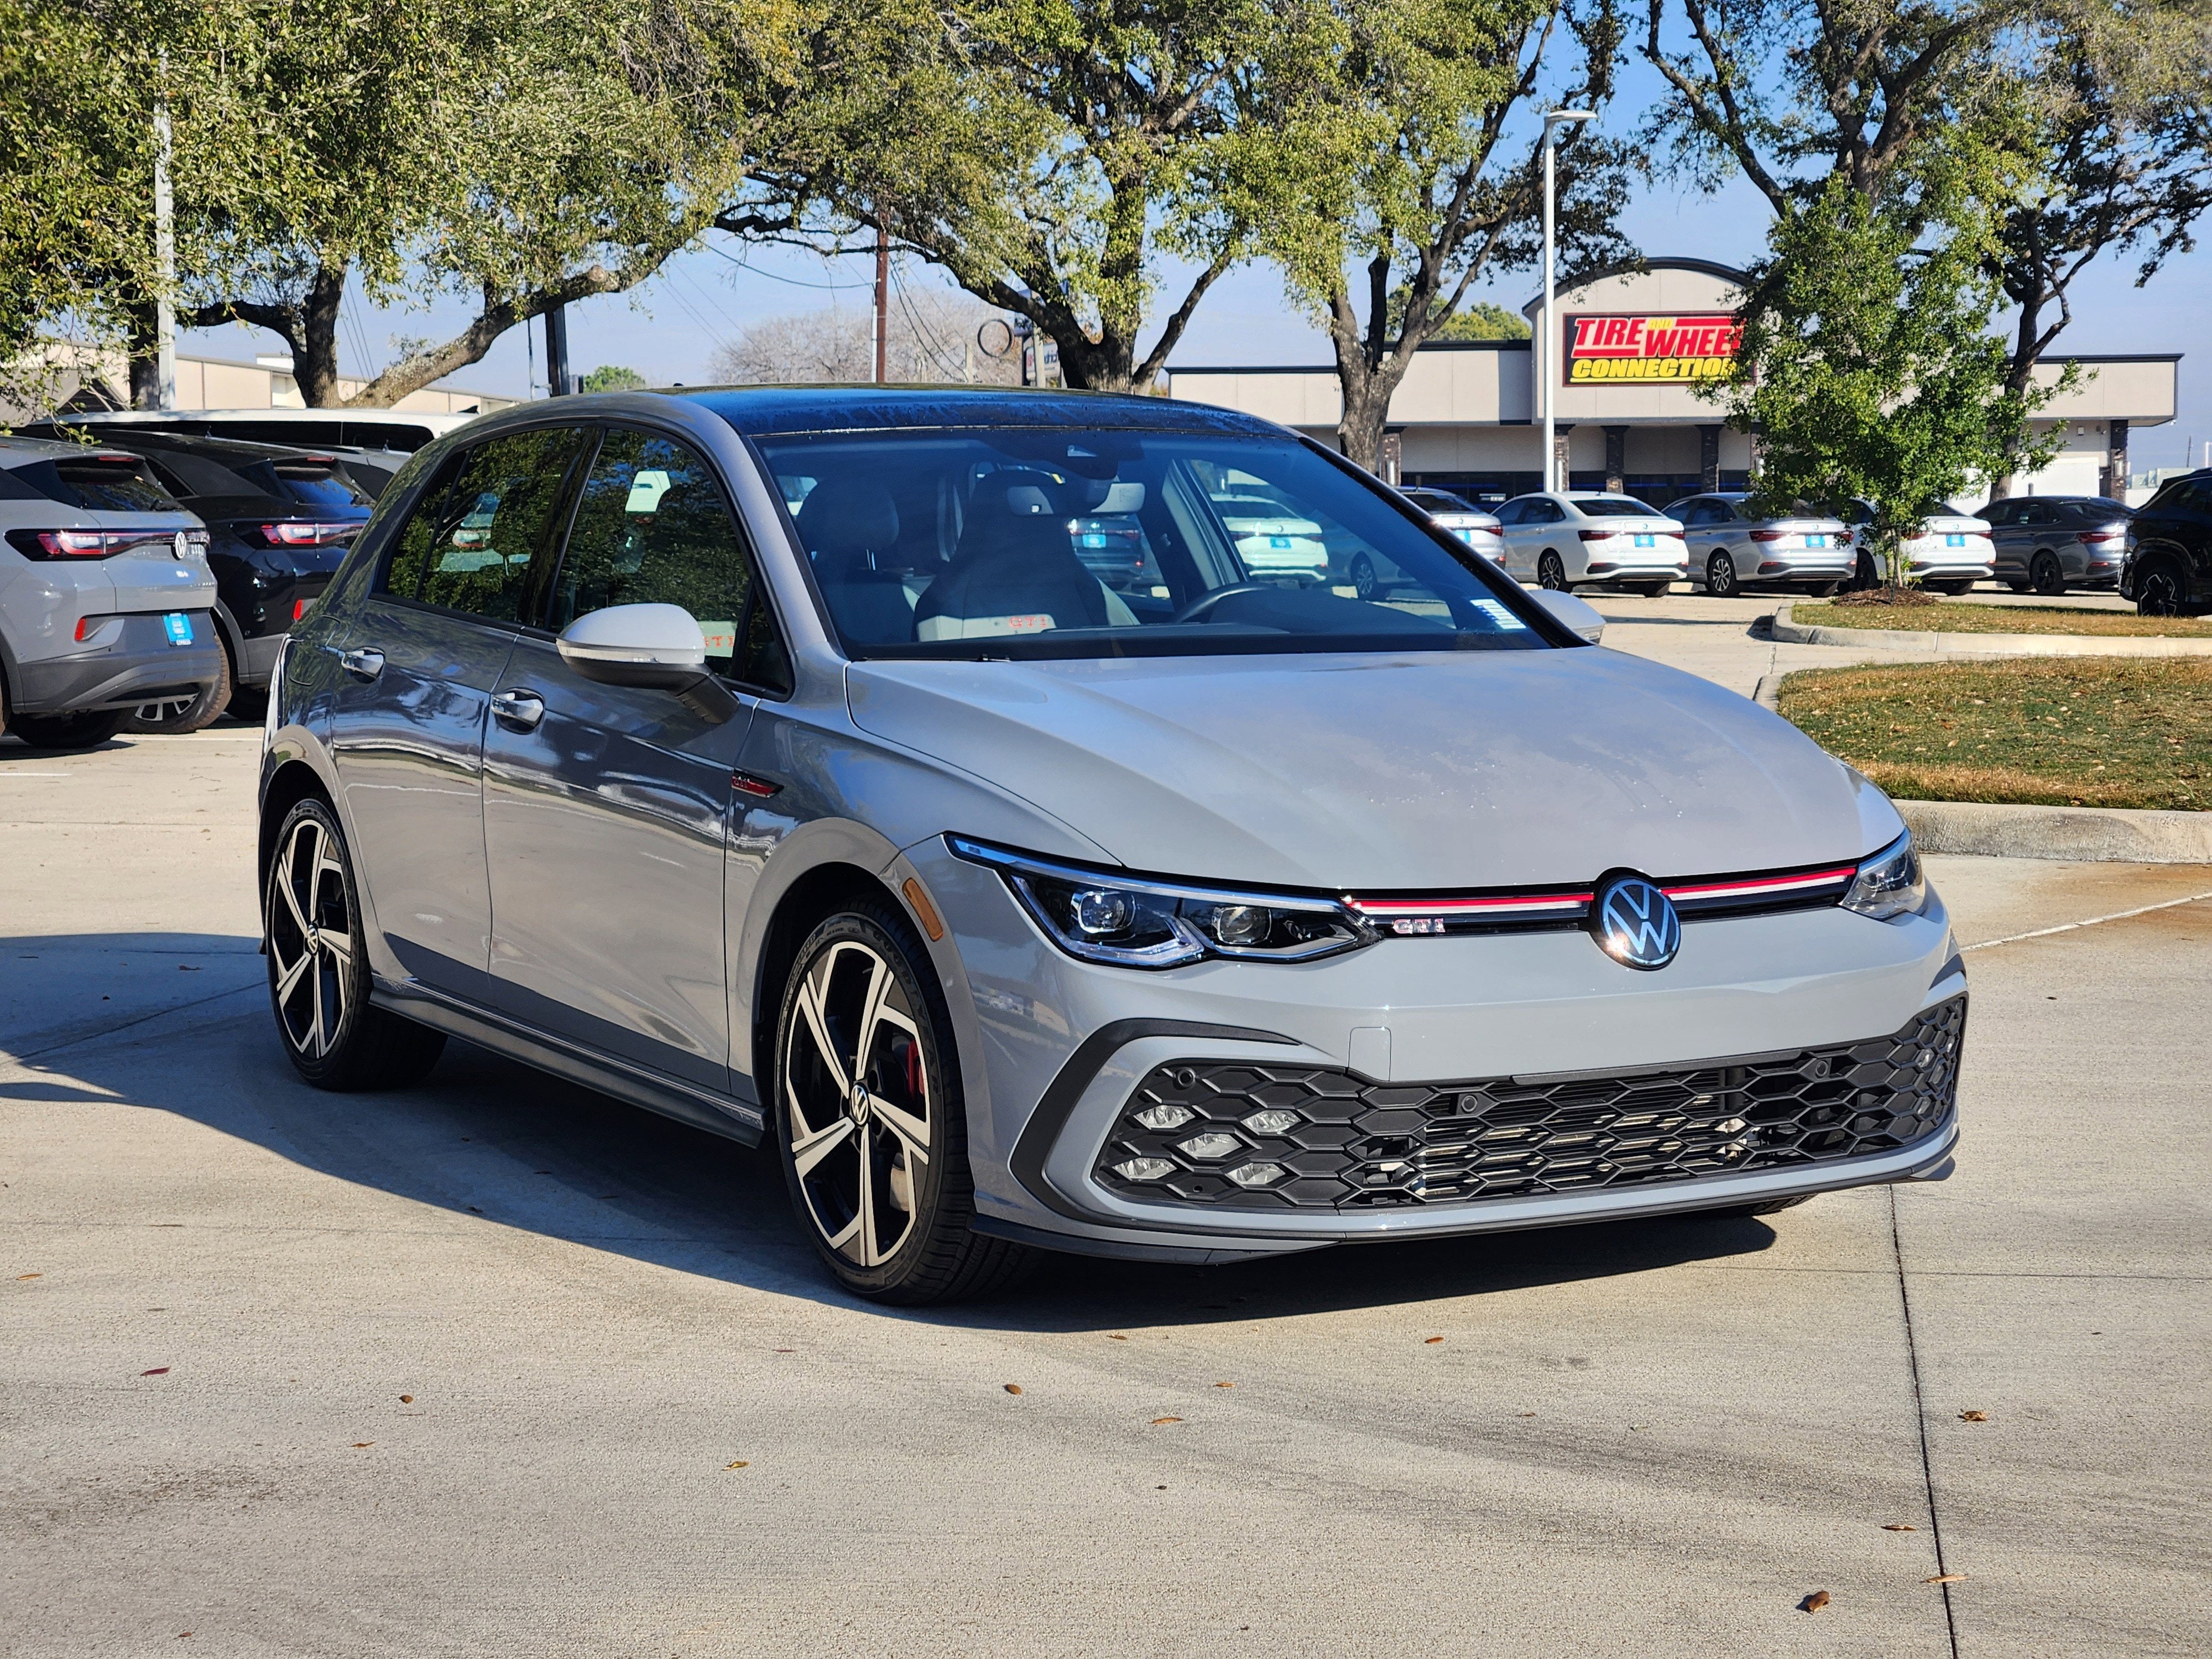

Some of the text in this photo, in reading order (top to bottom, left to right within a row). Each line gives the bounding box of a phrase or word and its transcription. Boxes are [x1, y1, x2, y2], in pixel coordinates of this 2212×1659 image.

[1575, 319, 1646, 346] TIRE
[1647, 318, 1673, 330] AND
[1009, 616, 1048, 628] GTI
[1393, 918, 1446, 934] GTI
